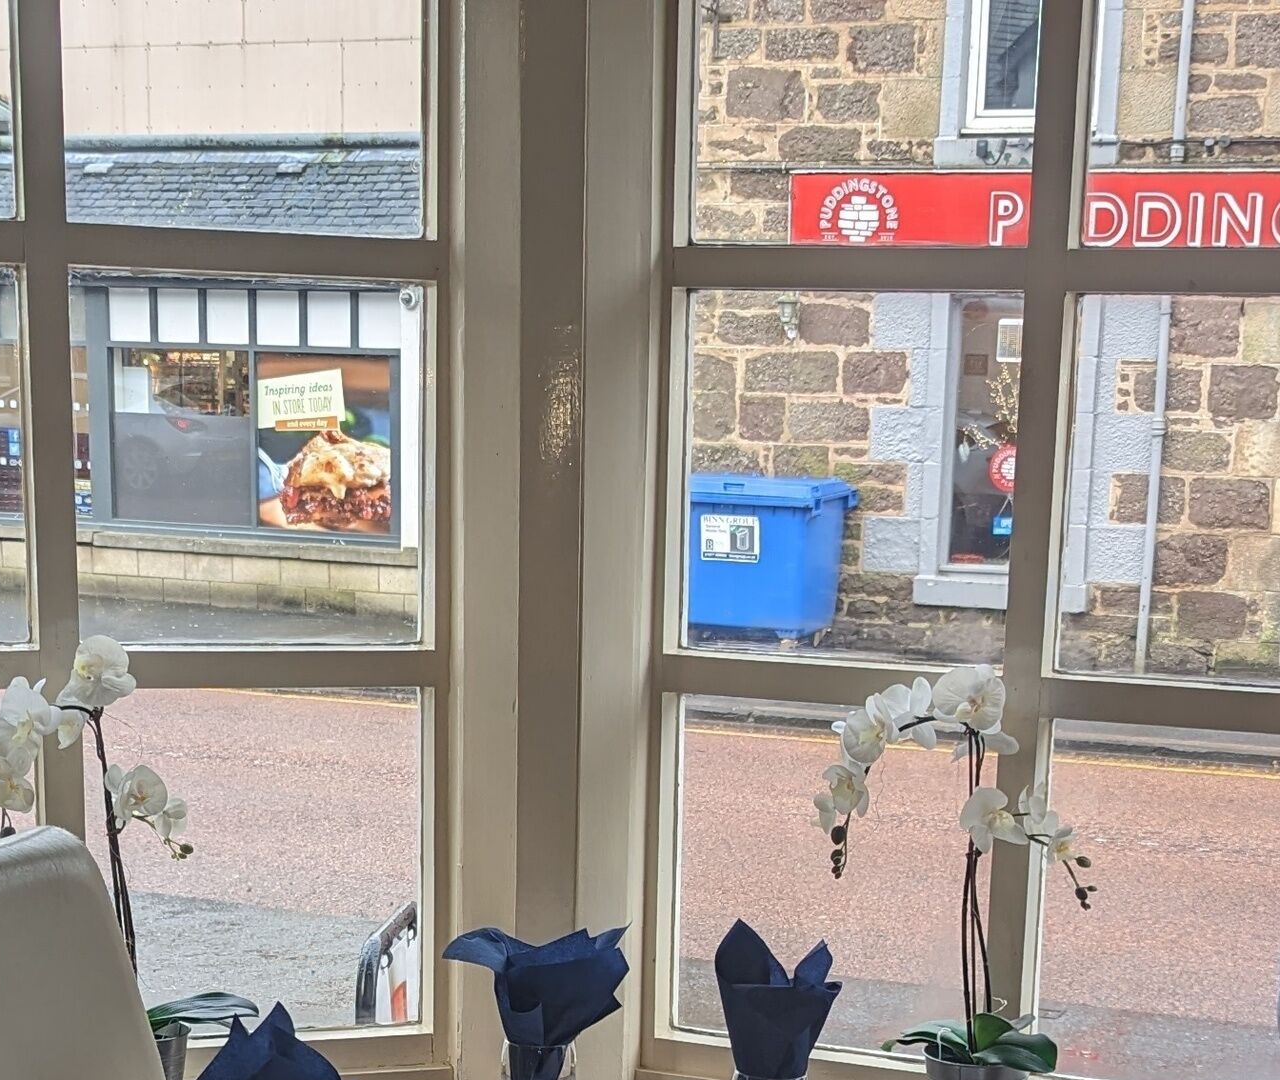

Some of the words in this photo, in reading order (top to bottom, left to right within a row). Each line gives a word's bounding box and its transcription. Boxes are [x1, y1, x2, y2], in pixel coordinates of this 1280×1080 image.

[819, 177, 899, 230] PUDDINGSTONE
[264, 384, 306, 398] Inspiring
[309, 381, 333, 393] ideas
[272, 401, 282, 416] IN
[283, 399, 306, 415] STORE
[308, 396, 332, 413] TODAY
